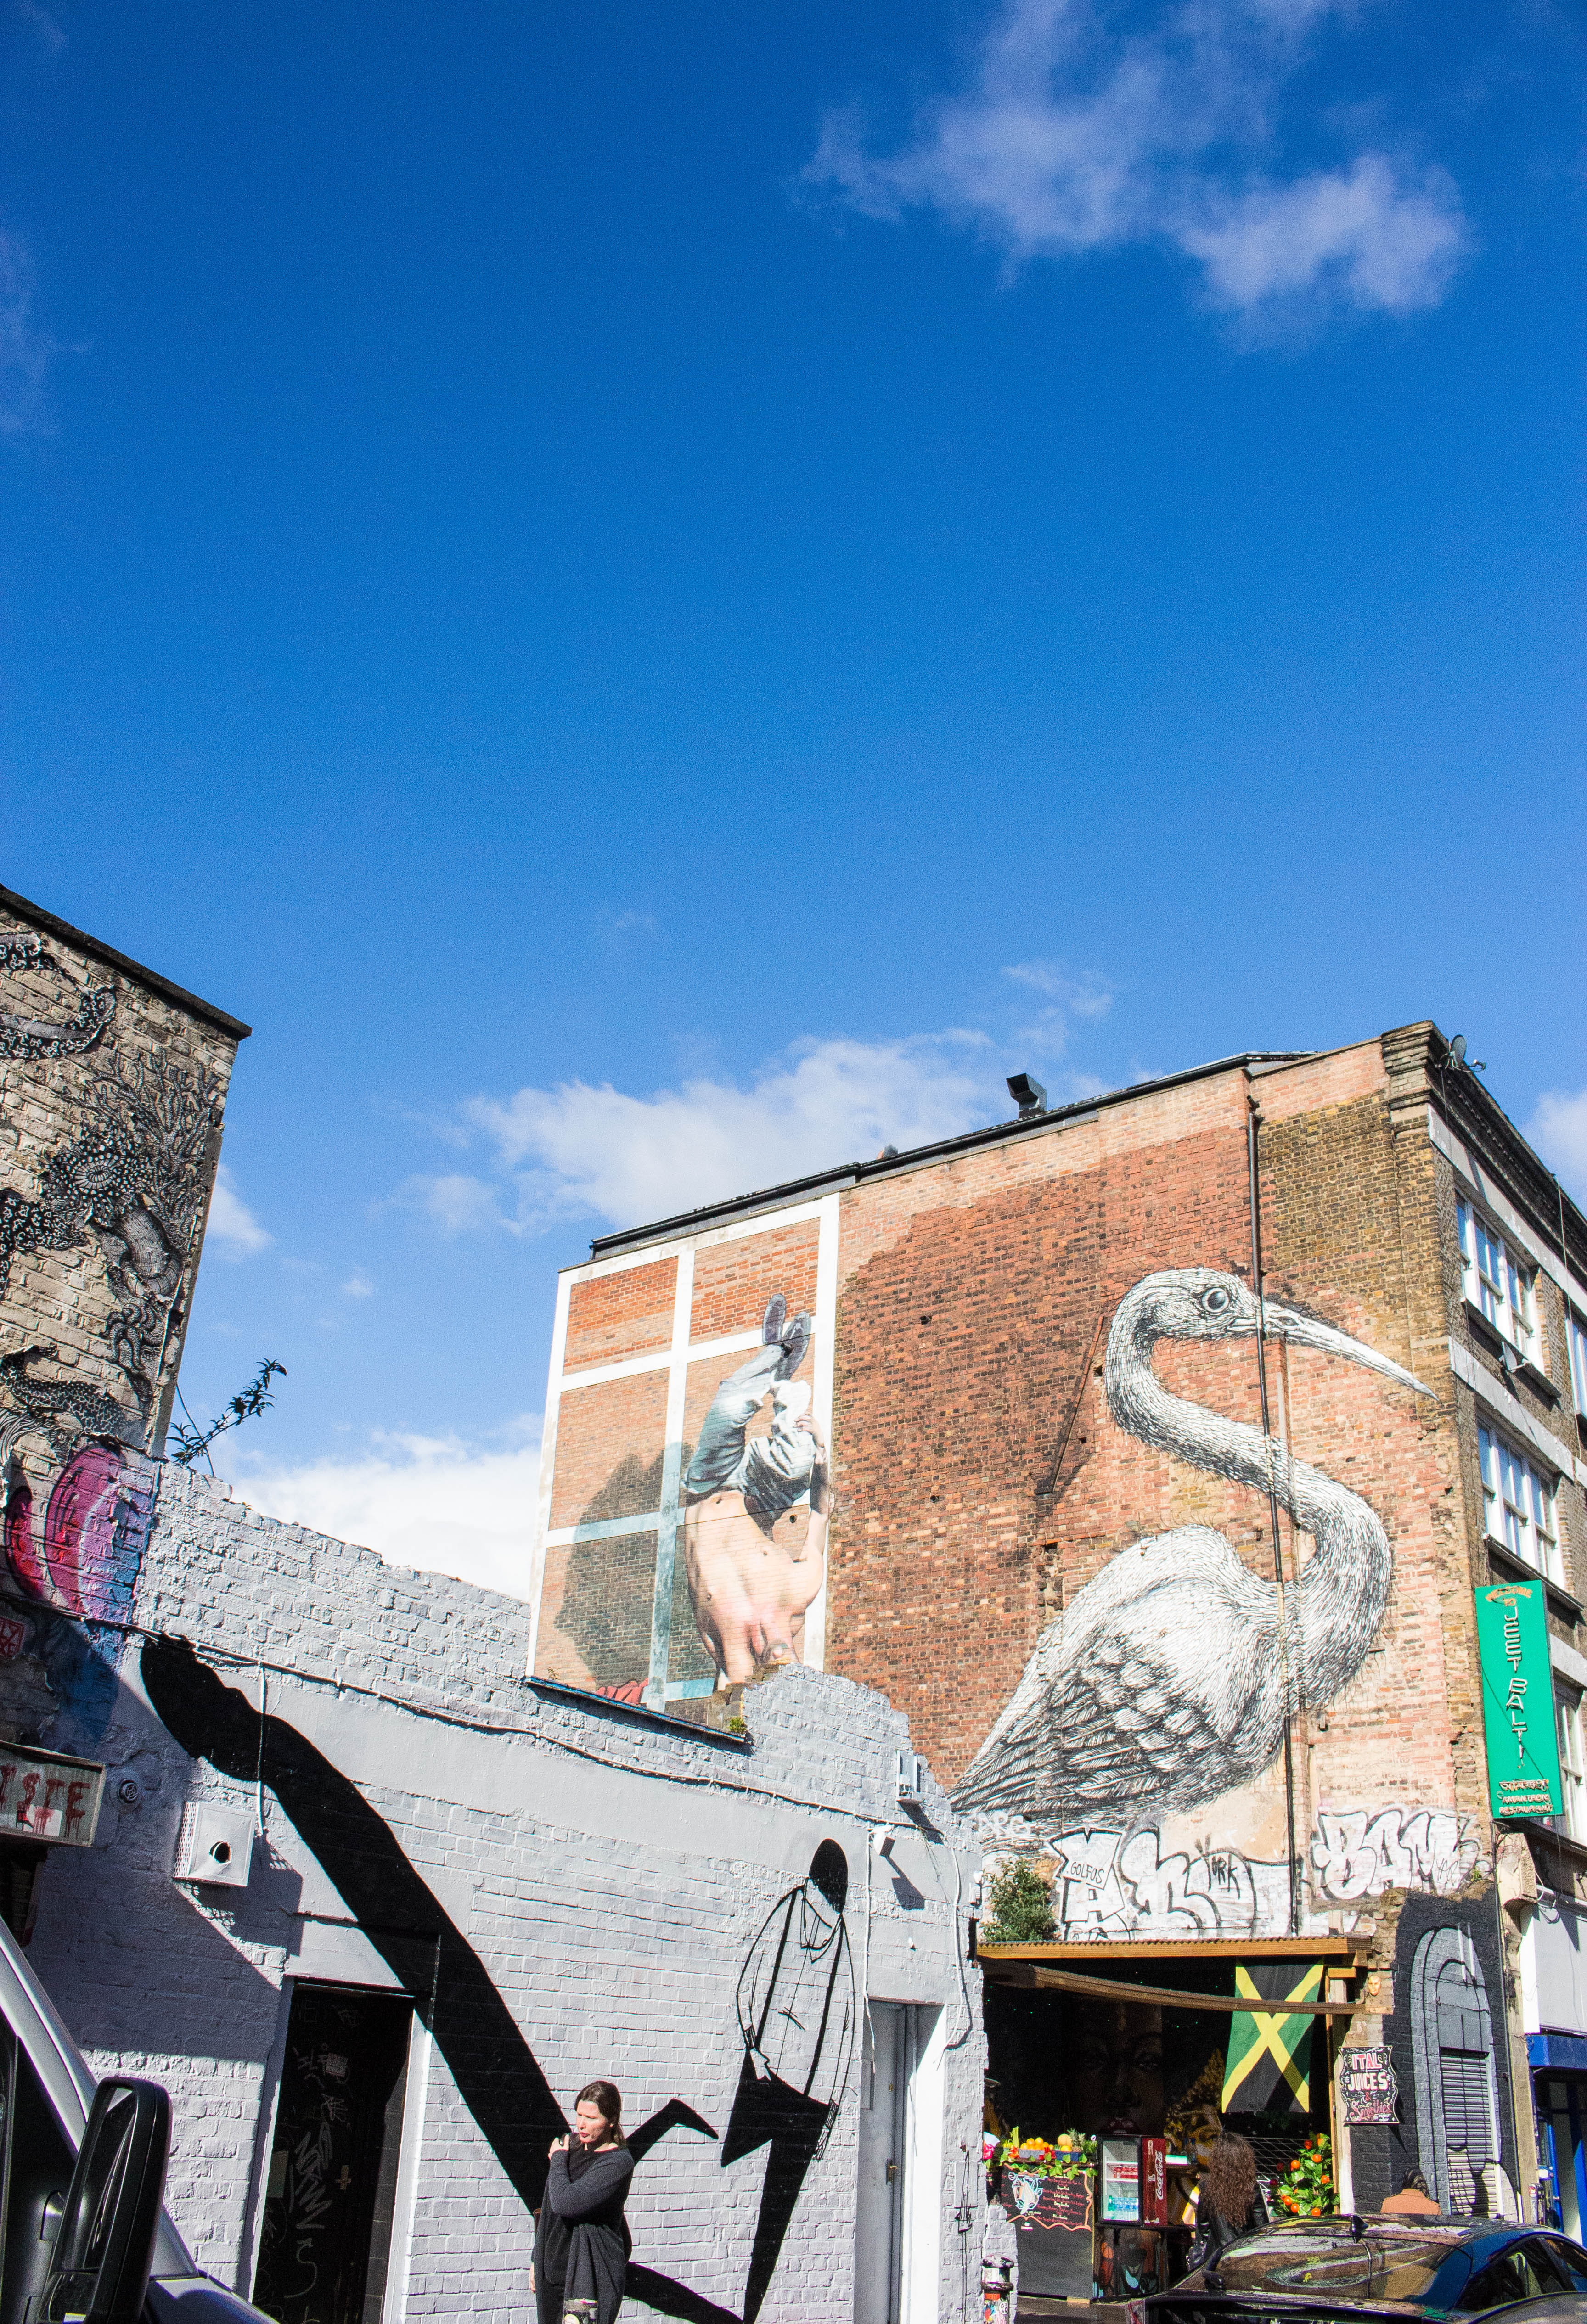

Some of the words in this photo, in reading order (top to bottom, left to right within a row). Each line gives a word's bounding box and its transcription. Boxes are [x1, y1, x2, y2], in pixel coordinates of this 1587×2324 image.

[1485, 1586, 1533, 1602] WELCOME
[1503, 1606, 1522, 1672] JEET
[1506, 1678, 1528, 1760] BALTI
[1499, 1804, 1553, 1814] RESTAURANT
[1070, 1862, 1105, 1884] GOLFOS
[1351, 2053, 1382, 2070] ITAL
[1347, 2072, 1389, 2091] JUICES
